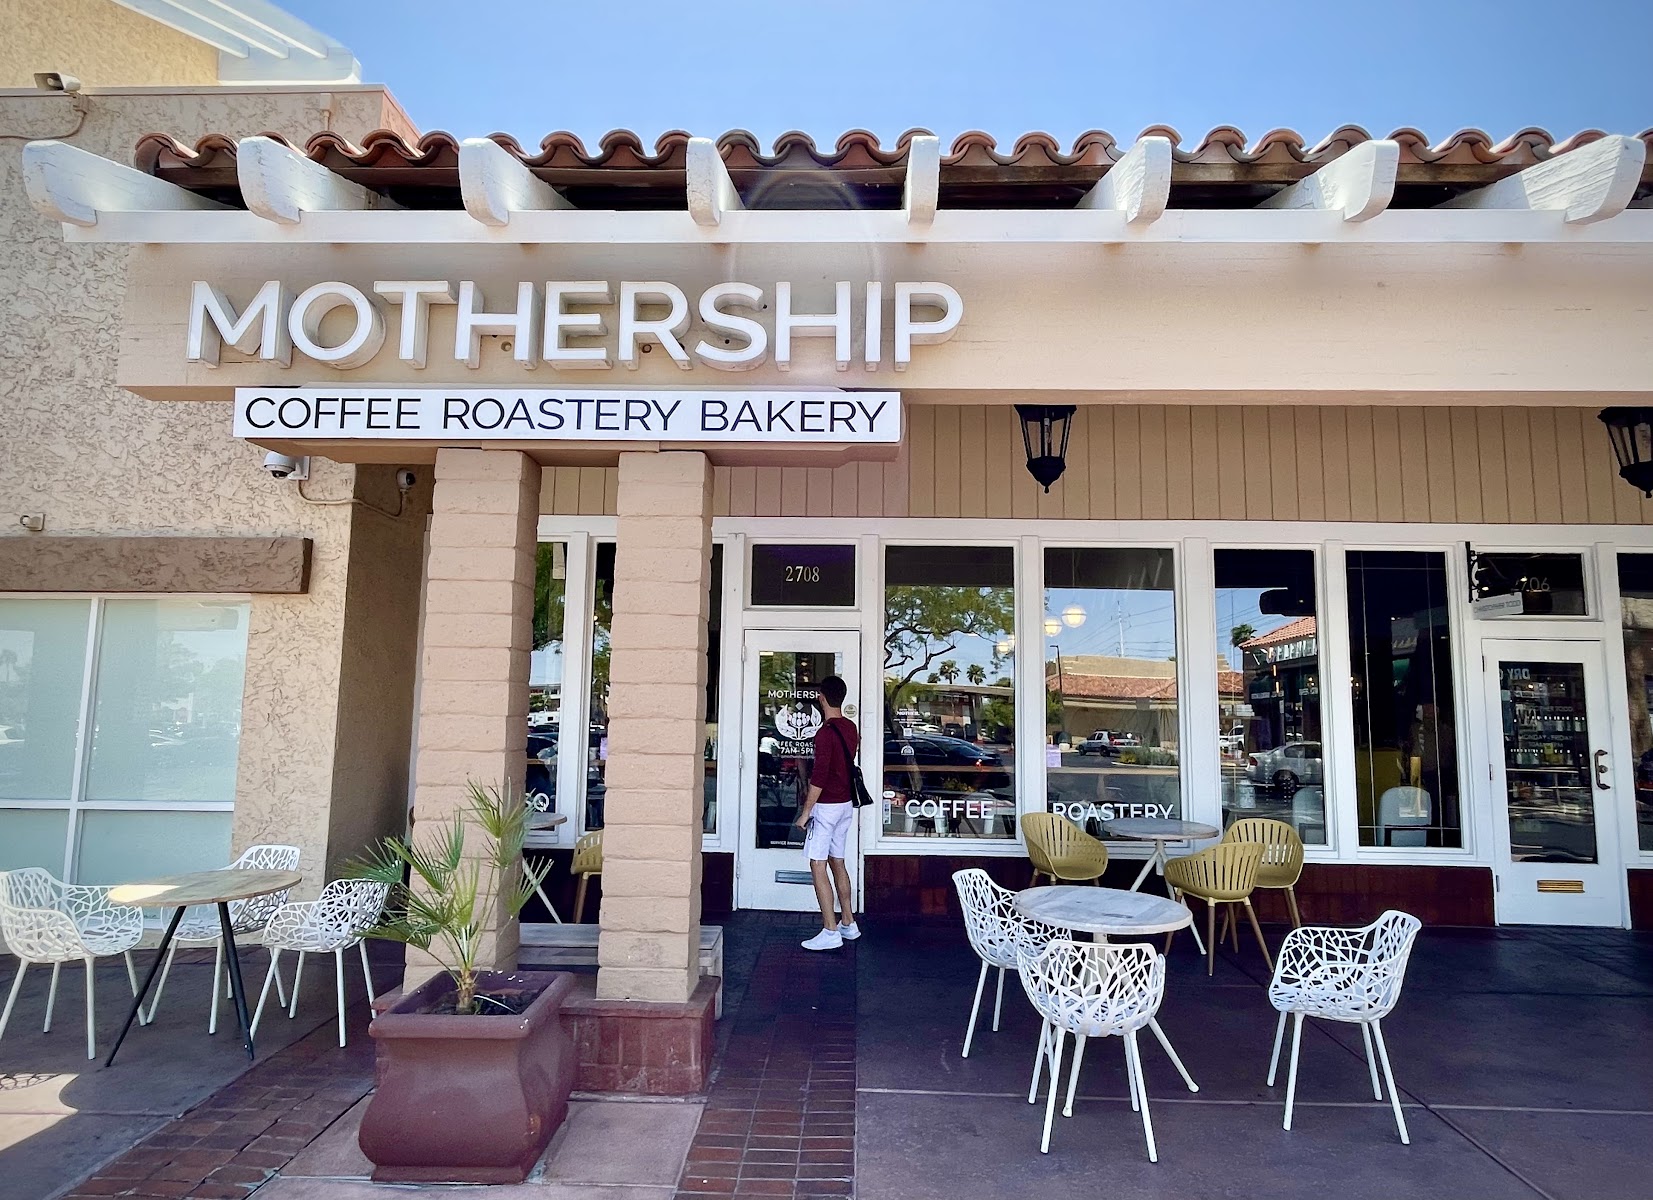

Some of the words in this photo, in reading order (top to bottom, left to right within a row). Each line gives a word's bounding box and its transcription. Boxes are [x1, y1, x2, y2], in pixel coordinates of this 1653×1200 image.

[187, 280, 964, 365] MOTHERSHIP
[245, 397, 421, 429] COFFEE
[442, 398, 682, 431] ROASTERY
[701, 399, 888, 433] BAKERY
[785, 565, 820, 582] 2708
[905, 799, 994, 819] COFFEE
[1052, 802, 1174, 822] ROASTERY
